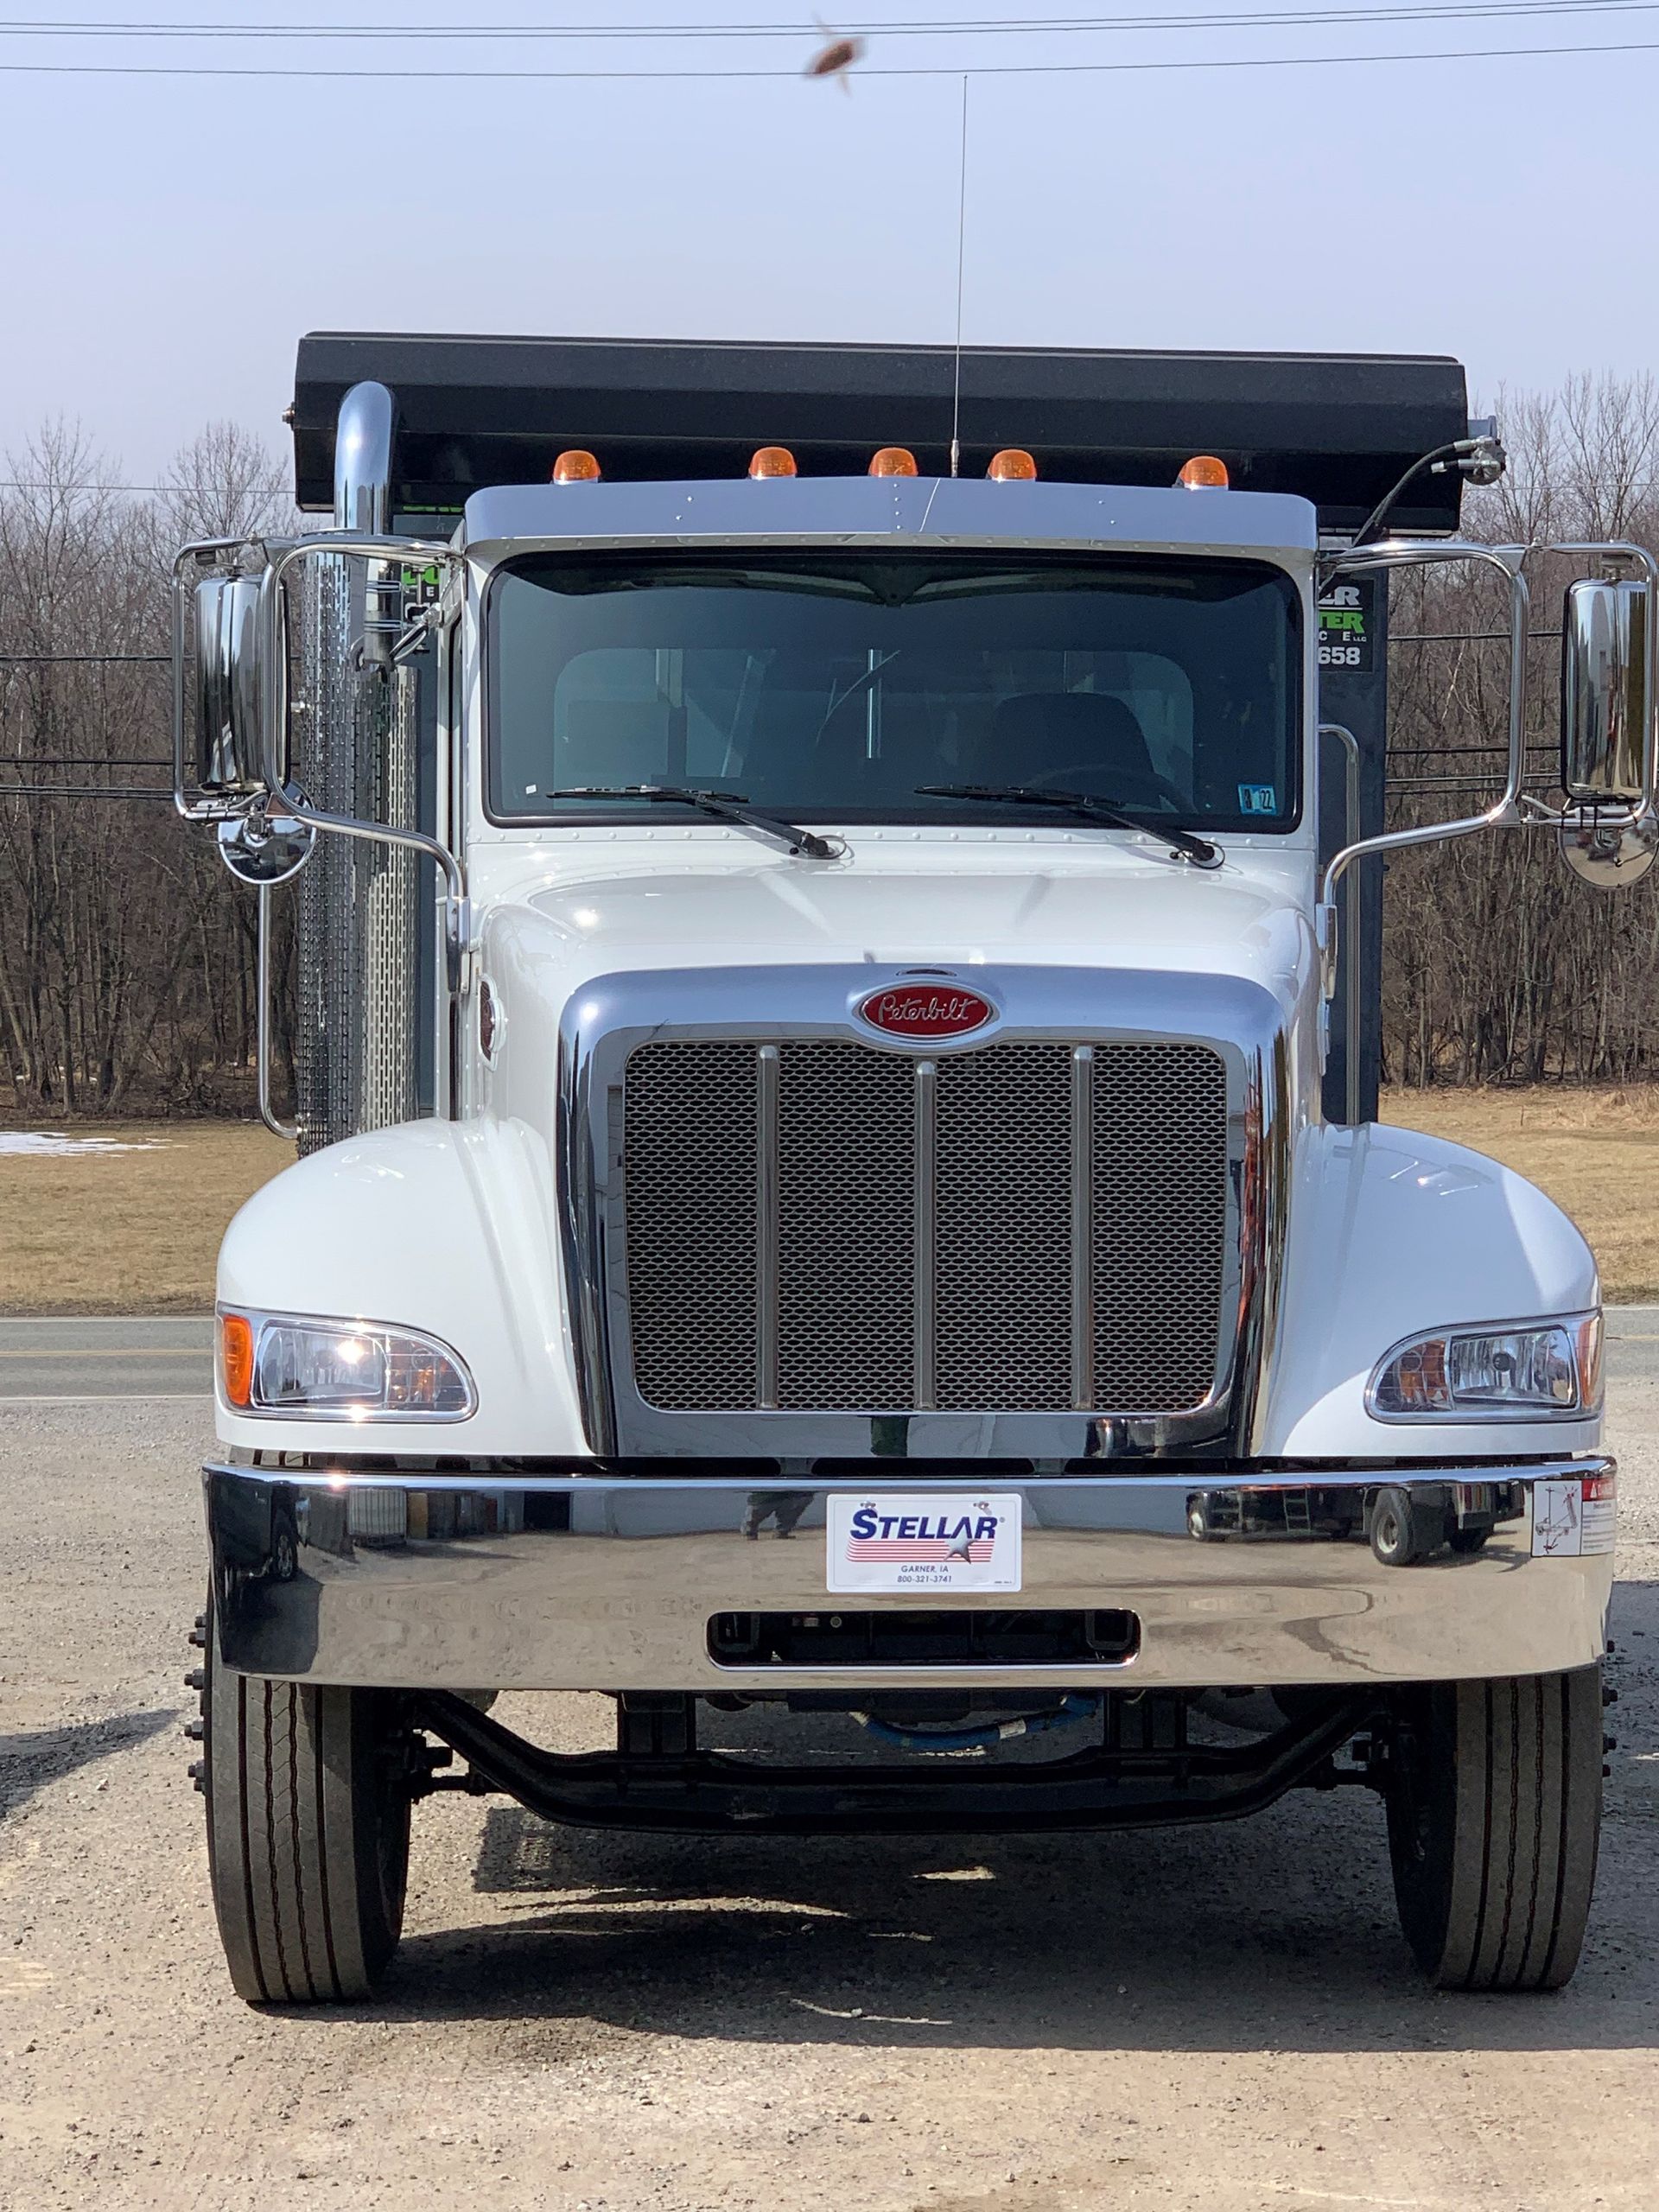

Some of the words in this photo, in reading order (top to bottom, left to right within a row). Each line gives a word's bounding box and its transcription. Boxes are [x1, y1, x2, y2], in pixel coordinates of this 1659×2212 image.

[1318, 646, 1361, 664] 658
[878, 995, 978, 1023] Peterbilt
[850, 1509, 998, 1540] STELLAR
[900, 1565, 938, 1573] GARNER,
